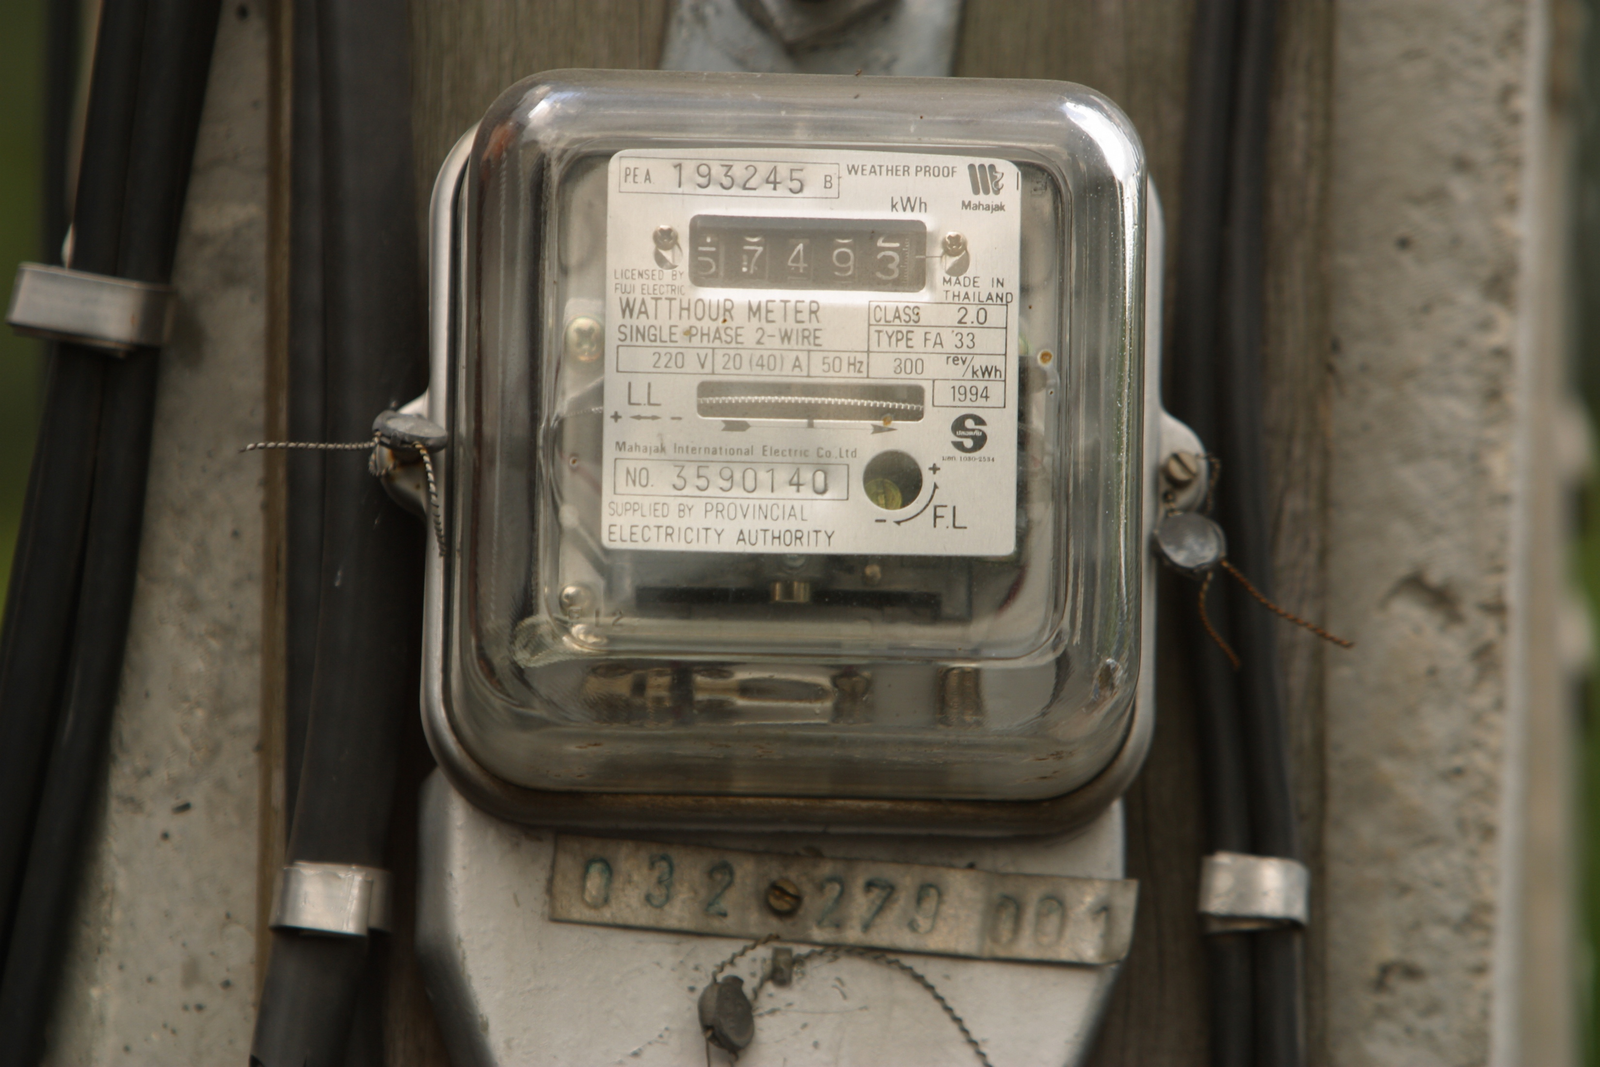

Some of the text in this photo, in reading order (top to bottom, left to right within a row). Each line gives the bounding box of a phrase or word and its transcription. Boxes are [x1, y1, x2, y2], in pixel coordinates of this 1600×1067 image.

[672, 162, 805, 195] 193245
[823, 174, 834, 190] B
[846, 163, 958, 179] WEATHER PROOF
[890, 196, 928, 213] kWh
[960, 199, 1006, 214] Mahajak
[613, 268, 685, 281] LICENSED BY
[942, 276, 1005, 289] MADE IN
[613, 283, 686, 296] FUJI ELECTRIC
[943, 289, 1014, 304] THAILAND
[618, 296, 820, 324] WATTHOUR METER
[873, 304, 988, 326] CLASS 2.0
[617, 323, 823, 347] SINGLE PHASE 2-WIRE
[874, 329, 915, 349] TYPE
[923, 332, 945, 350] FA
[651, 351, 708, 370] 220 V
[791, 354, 803, 373] A
[893, 357, 925, 376] 300
[950, 385, 990, 403] 1994
[614, 440, 667, 456] Mahajak
[673, 442, 754, 457] International
[761, 444, 810, 458] Electric
[671, 464, 829, 496] 3590140
[608, 501, 809, 522] SUPPLIED BY PROVINCIAL
[607, 524, 835, 548] ELECTRICITY AUTHORITY
